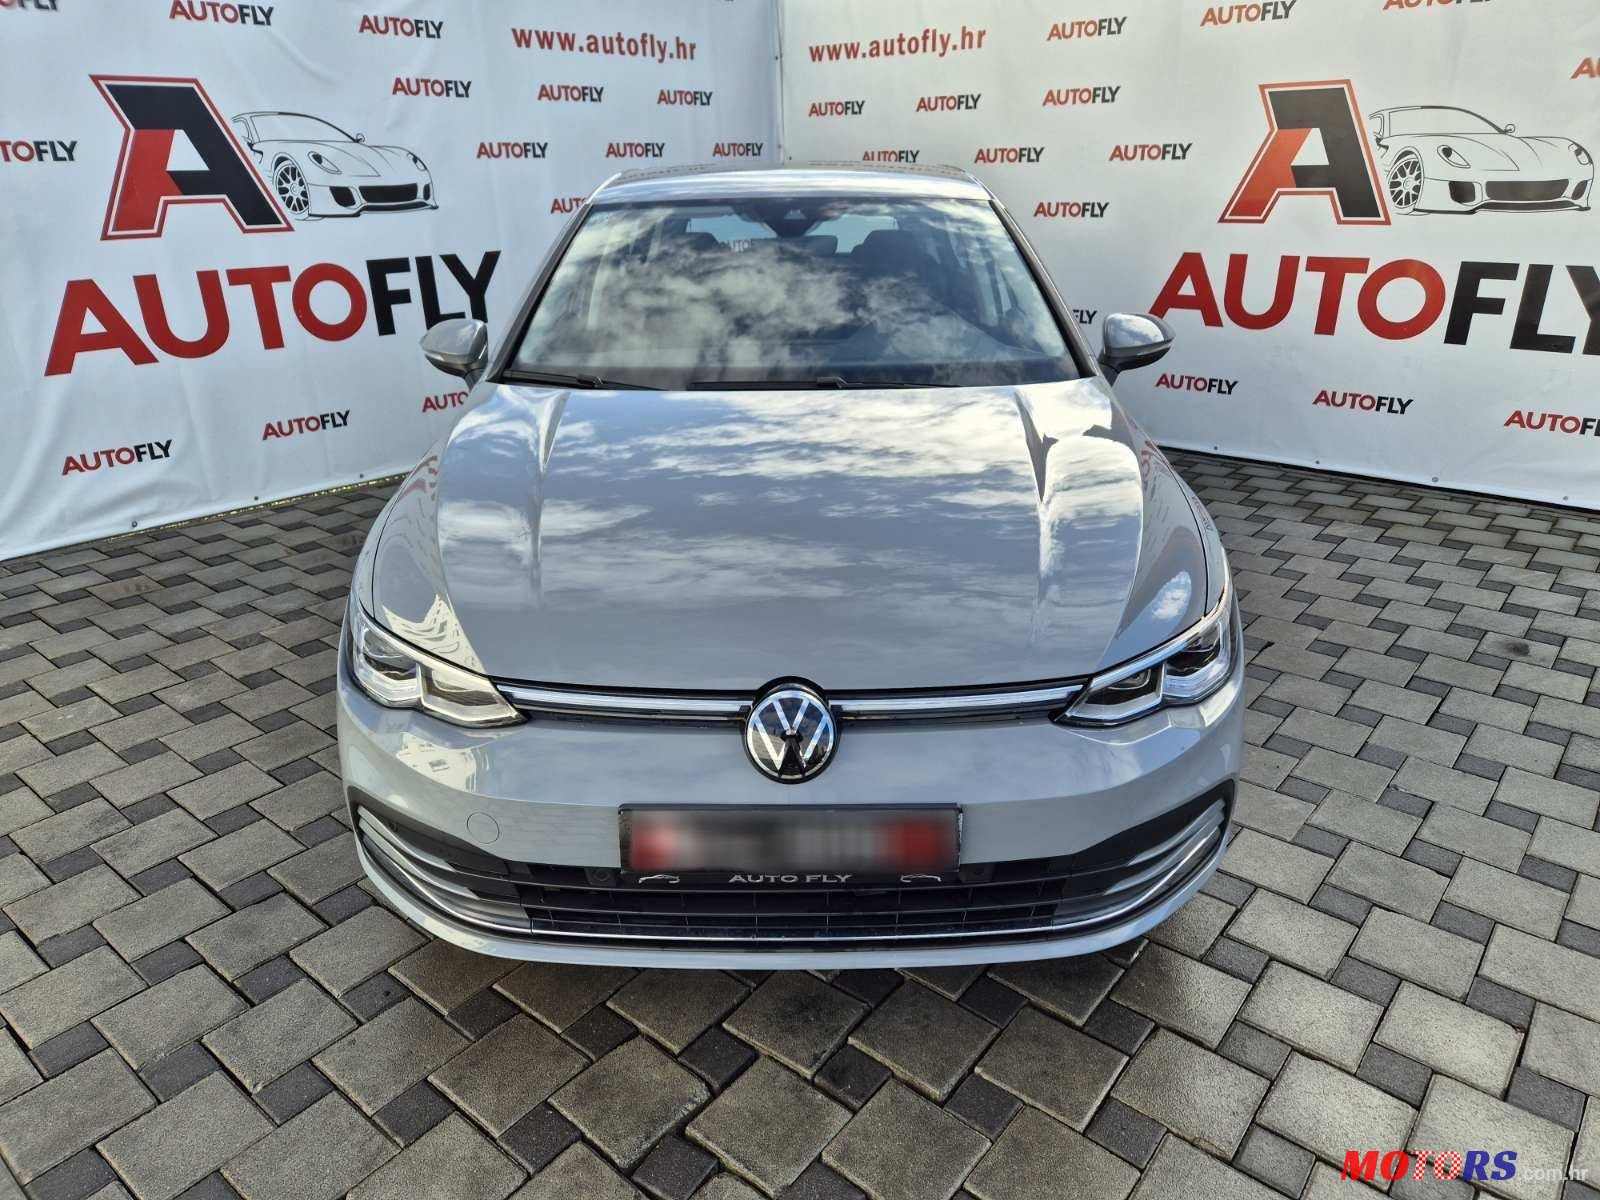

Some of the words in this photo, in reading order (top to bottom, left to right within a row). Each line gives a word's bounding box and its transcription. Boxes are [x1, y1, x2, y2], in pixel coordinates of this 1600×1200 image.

[169, 0, 274, 26] AUTOFLY
[1200, 0, 1296, 26] AUTOFLY
[359, 14, 444, 39] AUTOFLY
[1047, 17, 1127, 41] AUTOFLY
[512, 27, 697, 63] www.autofly.hr
[809, 26, 986, 63] www.autofly.hr
[1570, 57, 1600, 79] A
[392, 77, 472, 98] AUTOFLY
[538, 84, 604, 103] AUTOFLY
[657, 90, 713, 106] AUTOFLY
[1043, 86, 1120, 107] AUTOFLY
[809, 100, 865, 117] AUTOFLY
[916, 94, 981, 112] AUTOFLY
[476, 142, 548, 159] AUTOFLY
[606, 142, 665, 158] AUTOFLY
[713, 142, 763, 157] AUTOFLY
[974, 147, 1044, 164] AUTOFLY
[1109, 143, 1192, 161] AUTOFLY
[551, 197, 585, 214] AUT
[1034, 202, 1109, 218] AUTOFLY
[44, 250, 501, 376] AUTOFLY
[1155, 373, 1238, 395] AUTOFLY
[1312, 390, 1413, 415] AUTOFLY
[263, 410, 350, 440] AUTOFLY
[62, 440, 173, 475] AUTOFLY
[728, 874, 799, 883] AUTO
[805, 874, 853, 883] FLY
